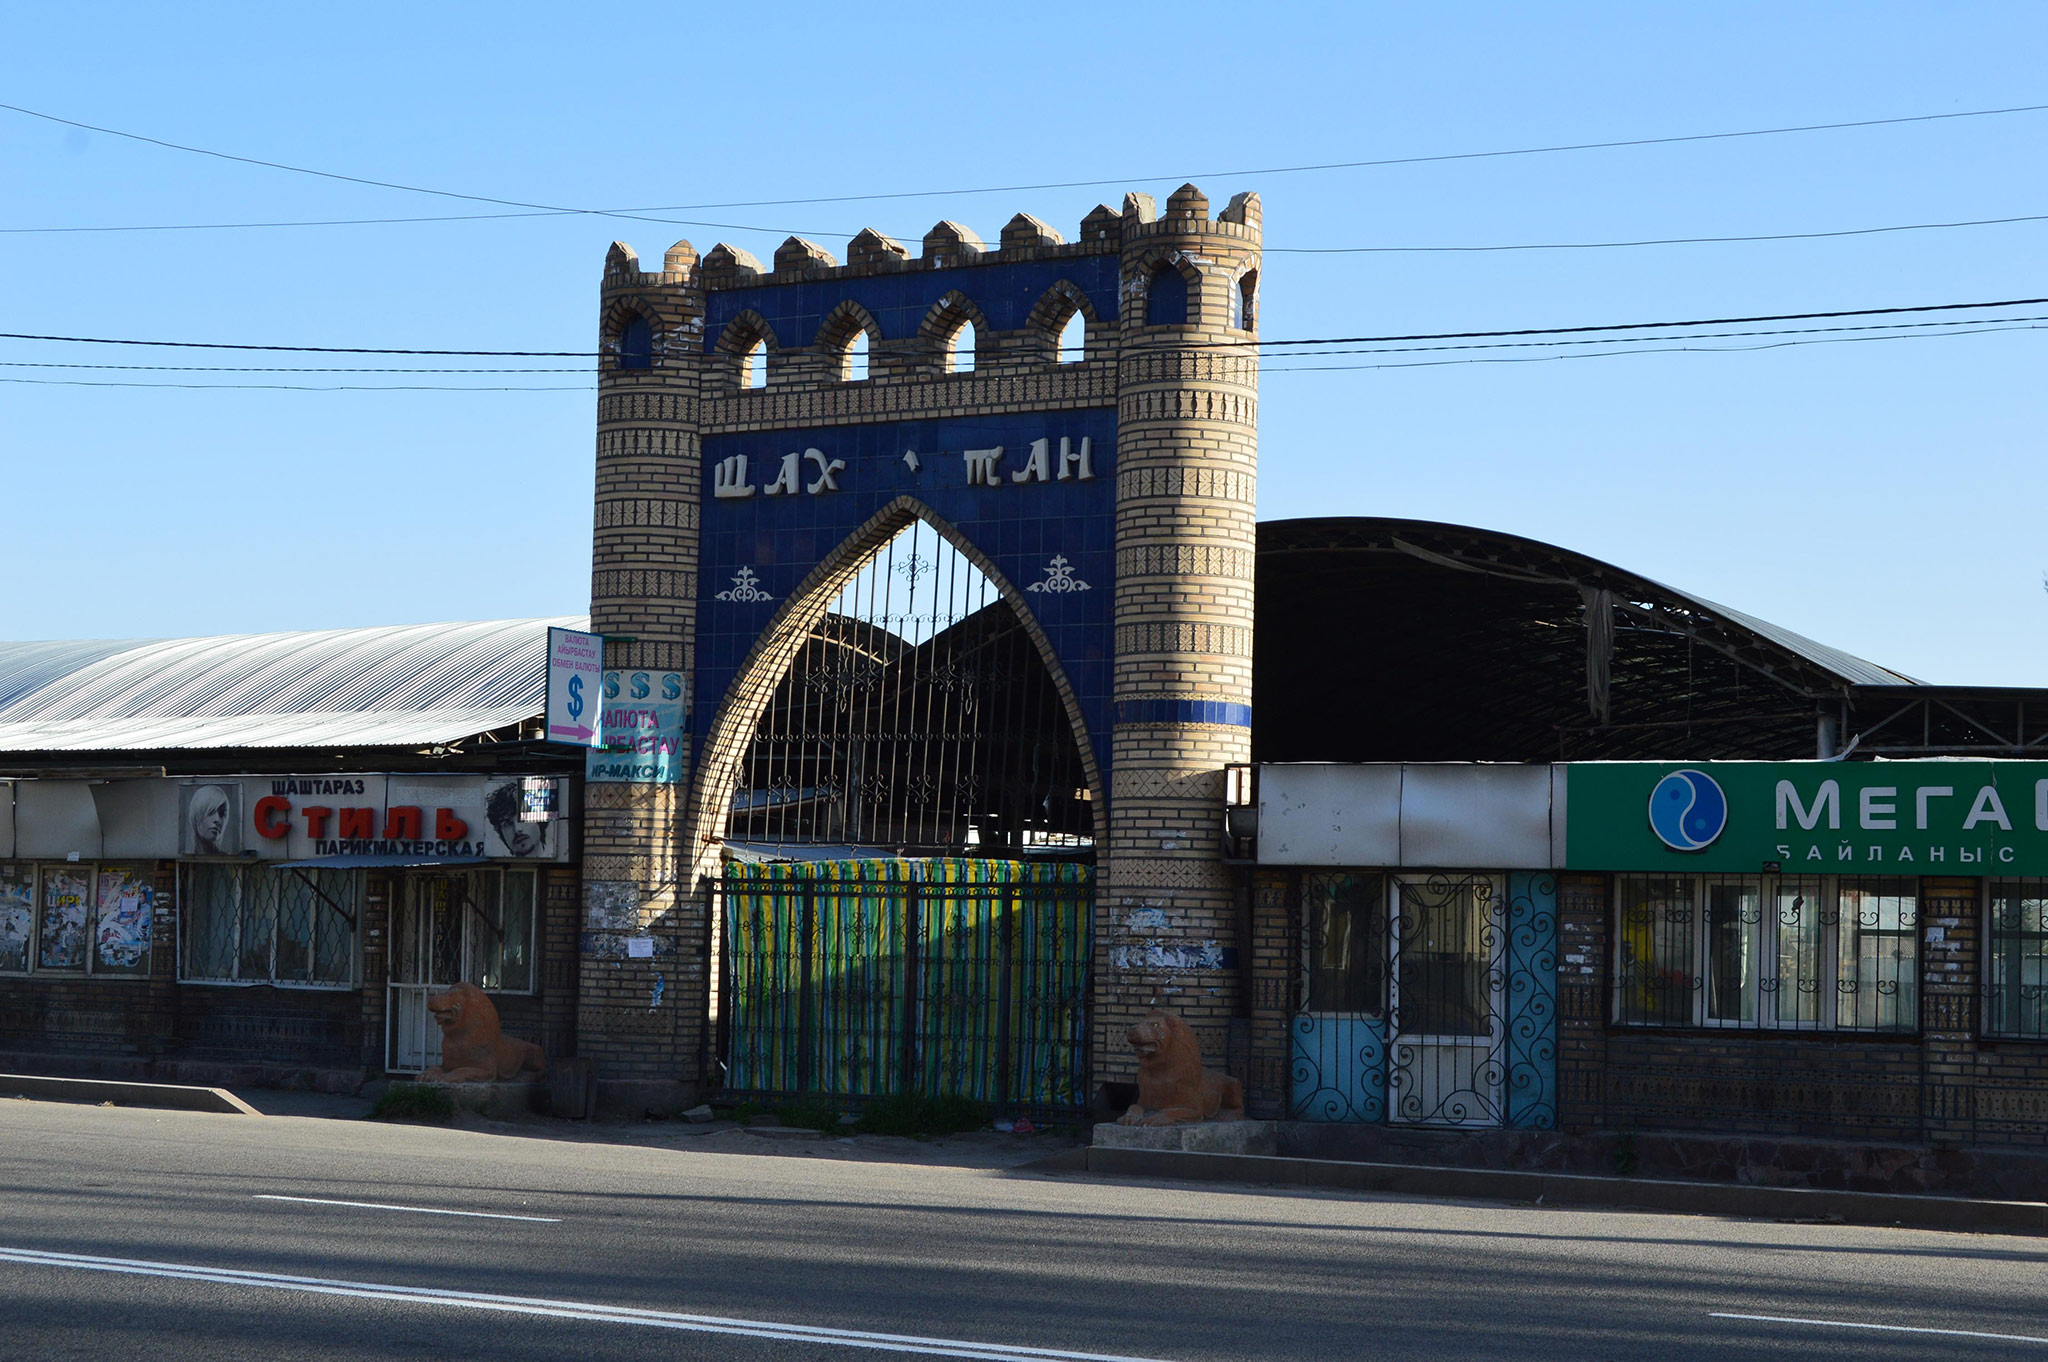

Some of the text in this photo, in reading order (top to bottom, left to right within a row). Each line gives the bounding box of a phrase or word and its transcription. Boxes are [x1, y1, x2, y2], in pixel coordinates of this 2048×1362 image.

[565, 634, 589, 646] ВАЛЮТА
[557, 644, 596, 658] АЙЫРБАСТАУ
[552, 658, 600, 673] ОБМЕН ВАЛЮТЫ
[272, 779, 364, 795] ШАШТАРАЗ
[1775, 778, 2048, 831] МЕГА
[315, 839, 484, 857] ПАРИКМАХЕРСКАЯ
[1776, 839, 2015, 863] БАЙЛАНЫС
